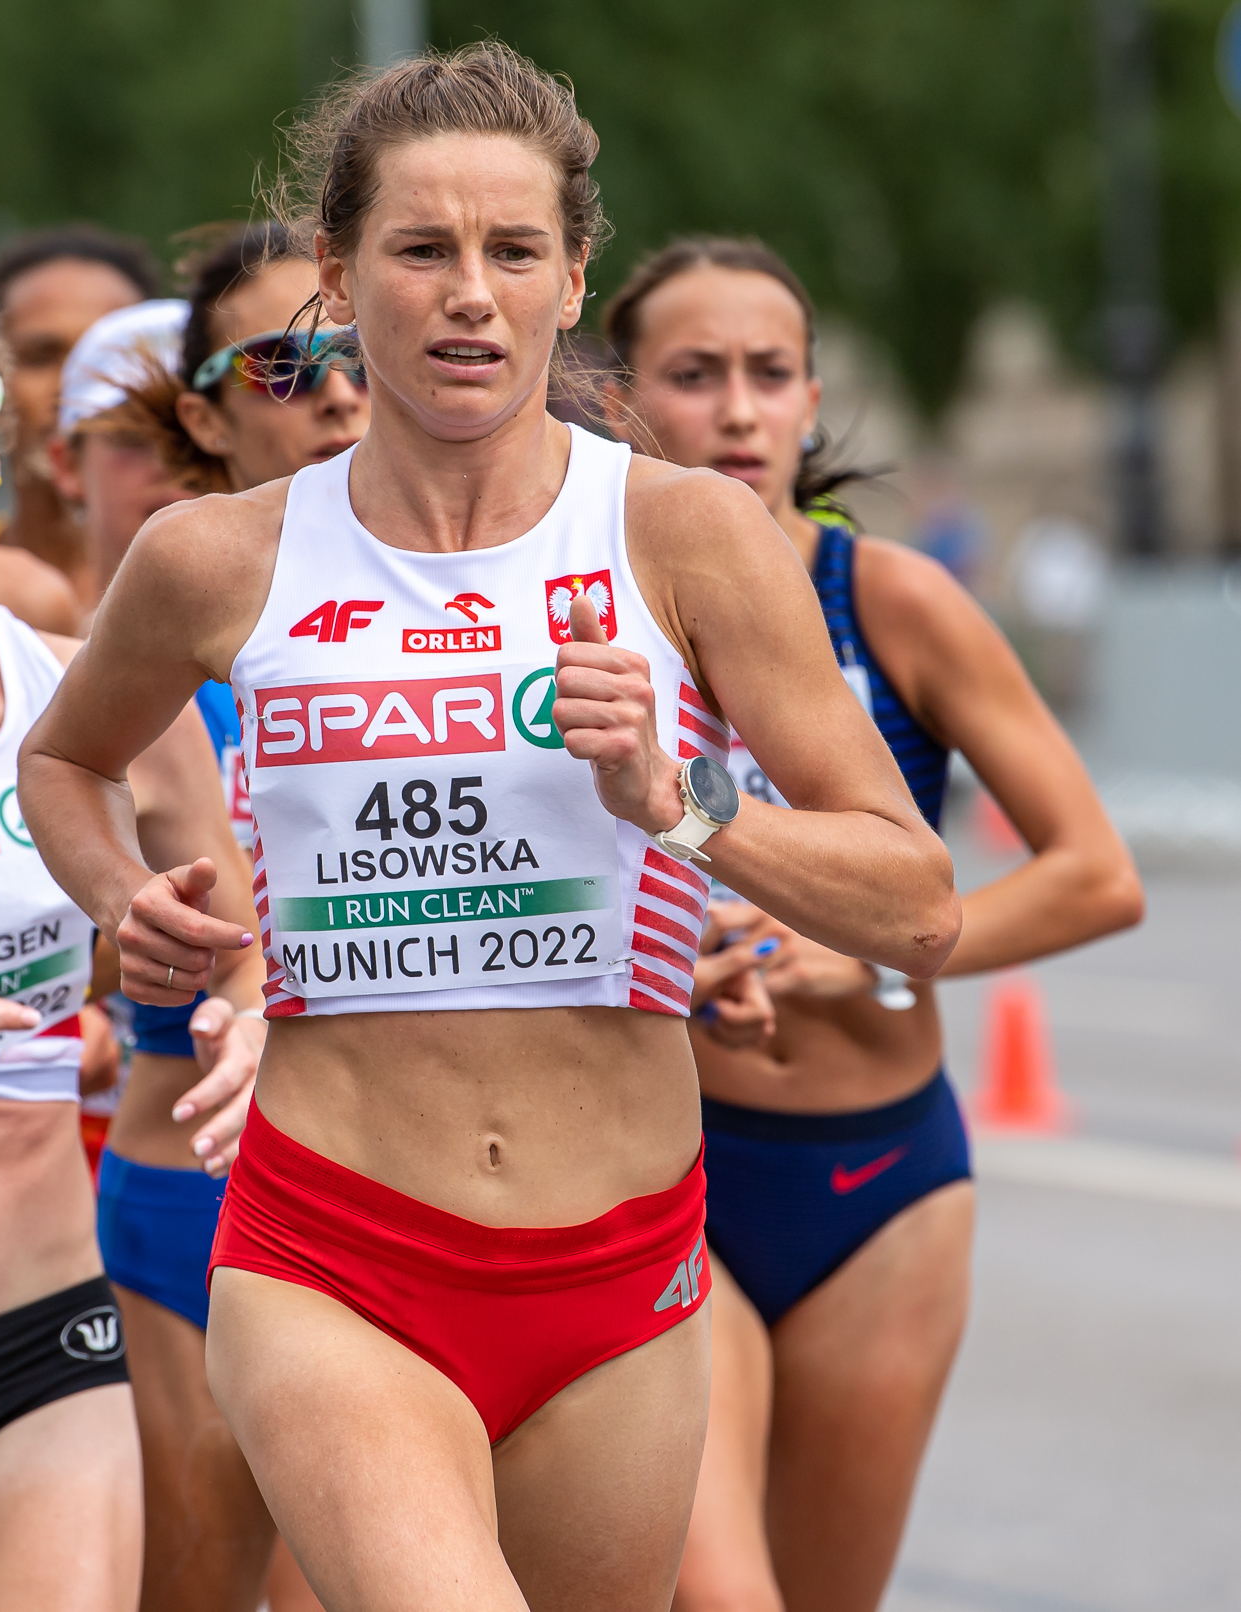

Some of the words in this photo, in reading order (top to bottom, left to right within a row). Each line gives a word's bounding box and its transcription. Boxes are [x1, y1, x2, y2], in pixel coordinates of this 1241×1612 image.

[407, 629, 495, 651] ORLEN
[262, 686, 498, 755] SPAR
[355, 775, 488, 841] 485
[316, 838, 539, 885] LISOWSKA
[327, 901, 335, 926] I
[346, 897, 410, 924] RUN
[283, 935, 460, 984] MUNICH
[479, 923, 598, 972] 2022
